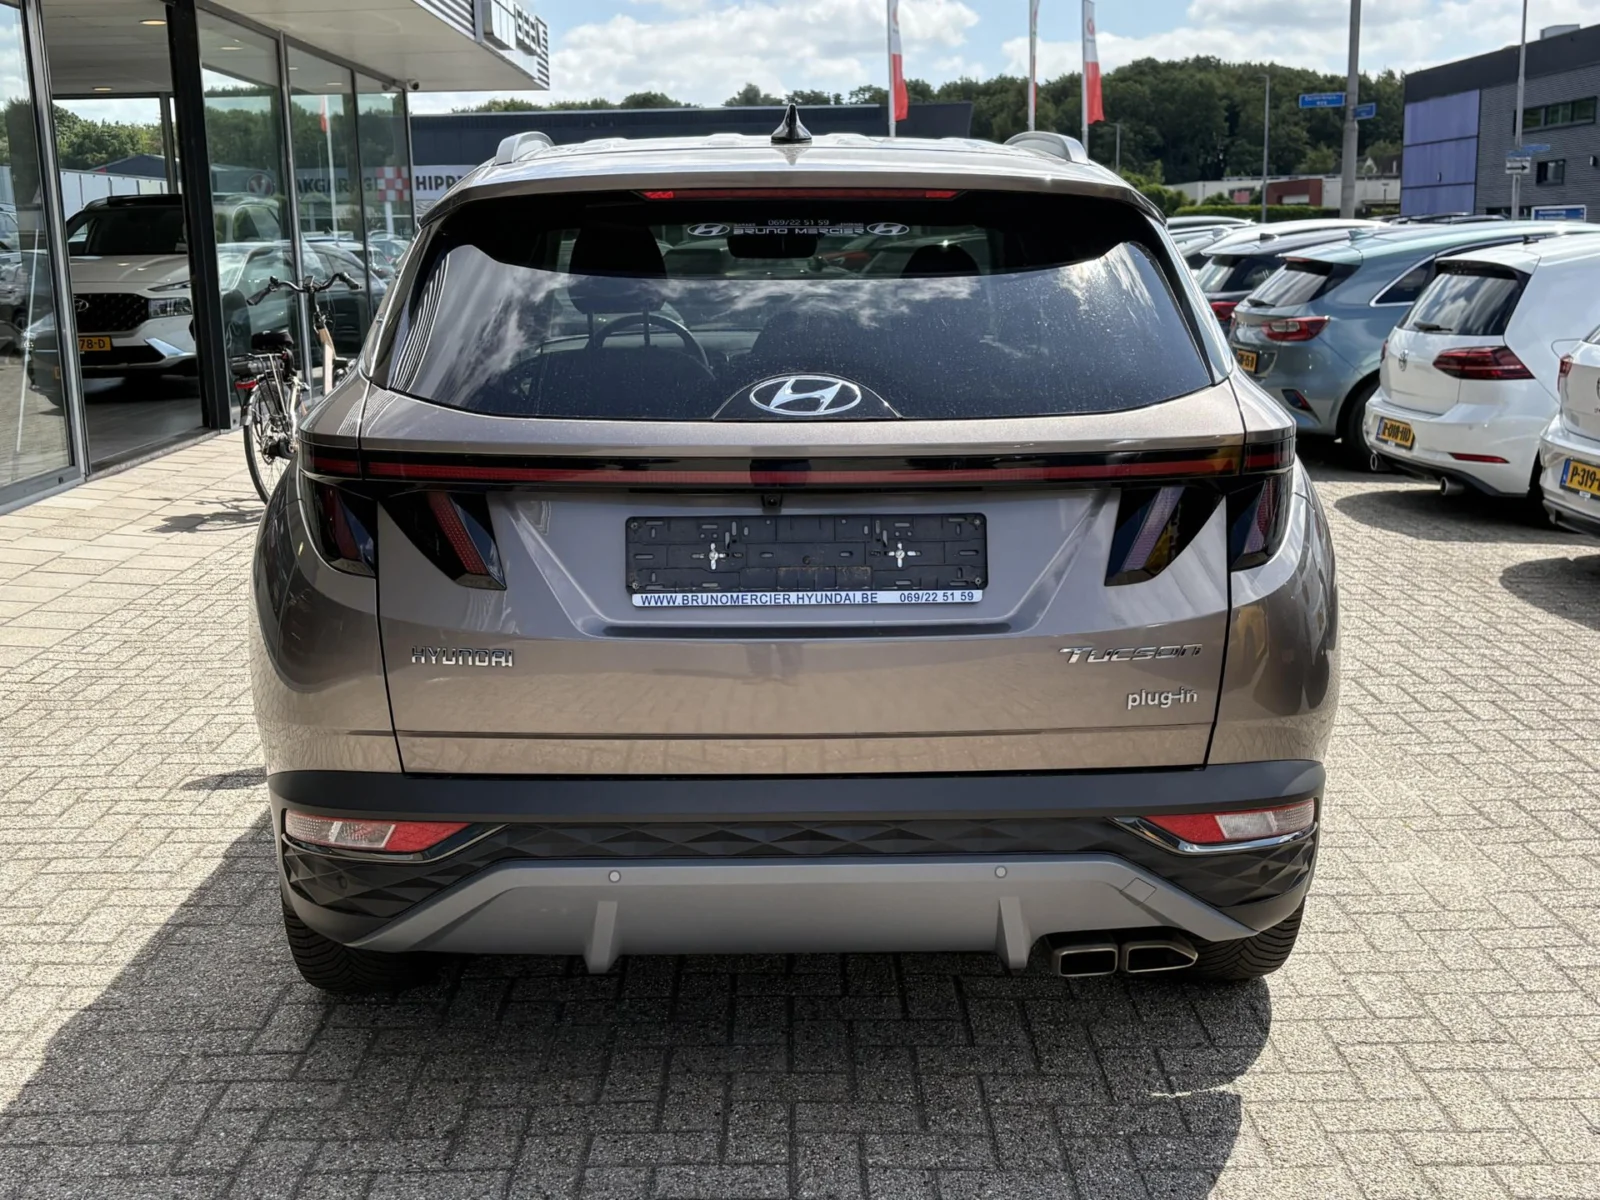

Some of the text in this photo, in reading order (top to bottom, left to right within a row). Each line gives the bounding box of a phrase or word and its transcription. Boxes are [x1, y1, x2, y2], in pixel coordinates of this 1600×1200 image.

[415, 175, 464, 191] HIPP
[733, 227, 865, 235] BRUNO MERCIER
[1569, 465, 1600, 491] P-319-
[641, 591, 975, 606] WWW.BRUNOMERCIER.HYUNDAI.BE 069/22 51 59
[411, 646, 513, 668] HYUNDAI
[1127, 686, 1198, 710] plug-in
